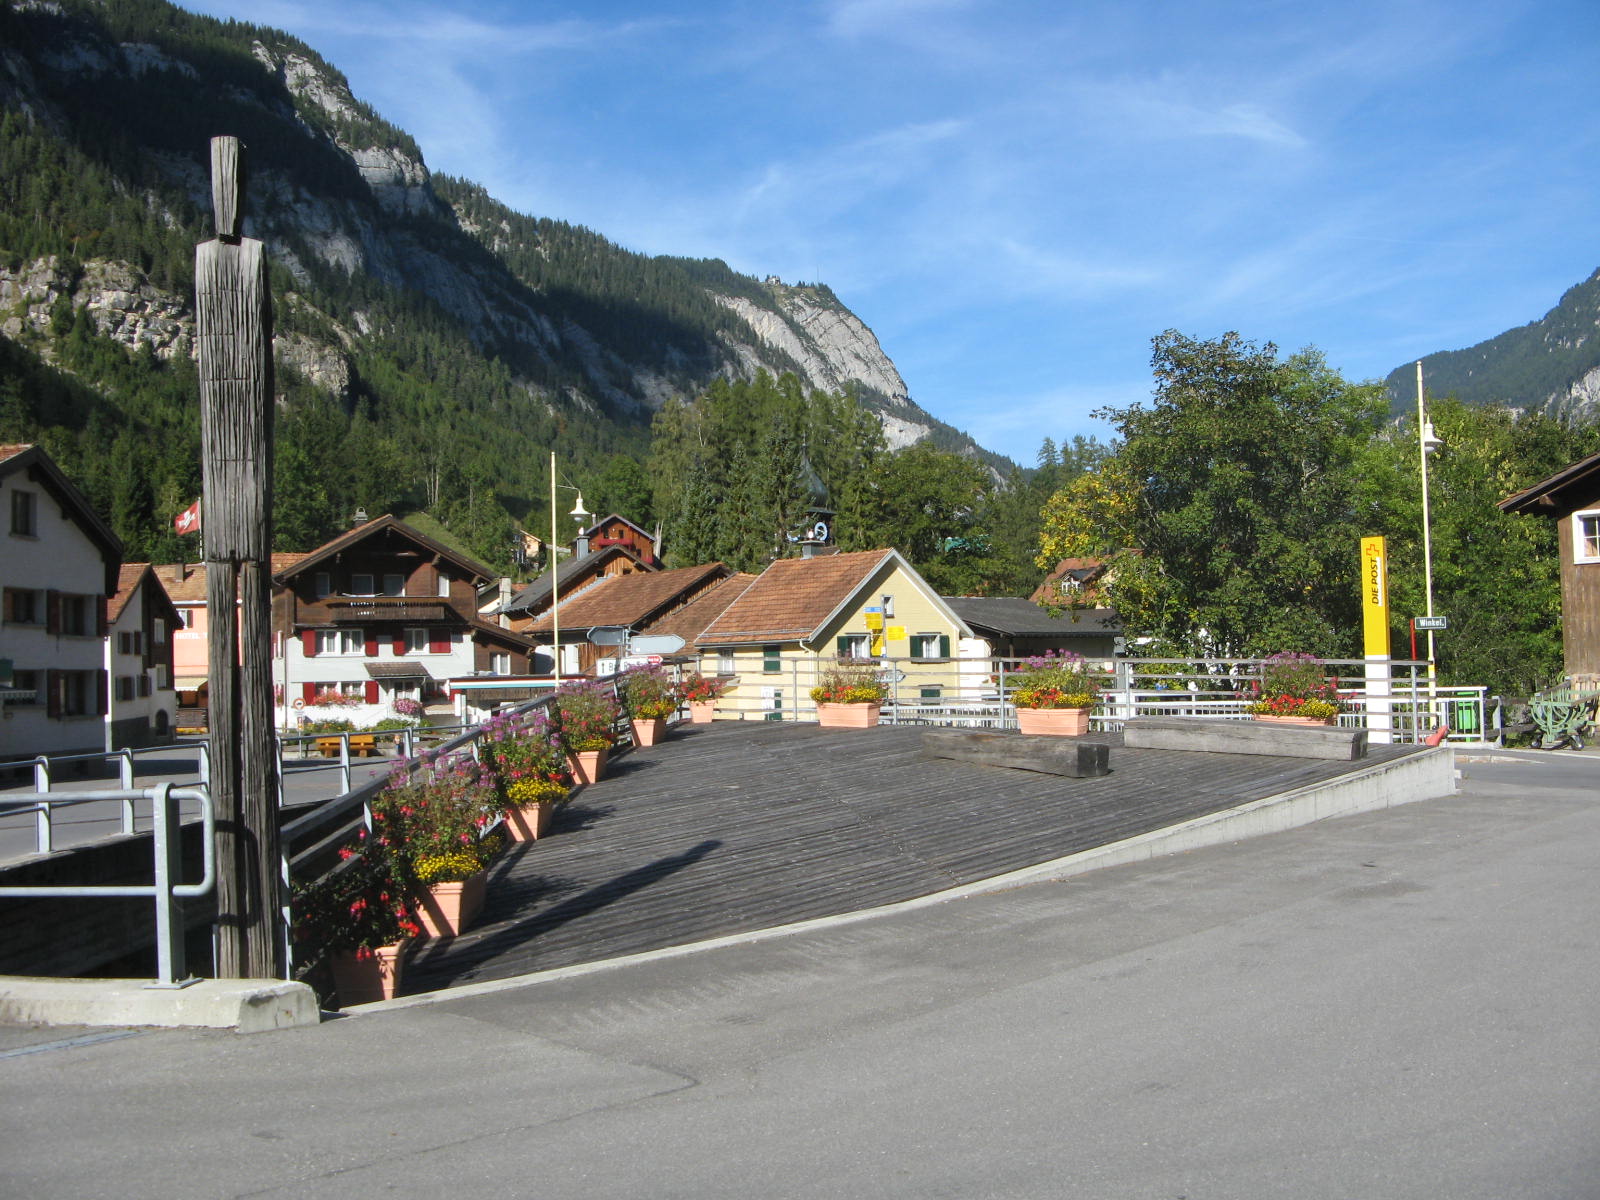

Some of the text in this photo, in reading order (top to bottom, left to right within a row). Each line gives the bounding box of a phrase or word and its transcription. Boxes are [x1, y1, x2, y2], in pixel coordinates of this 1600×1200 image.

[1370, 557, 1379, 605] DIE POST
[175, 632, 200, 640] HOTEL
